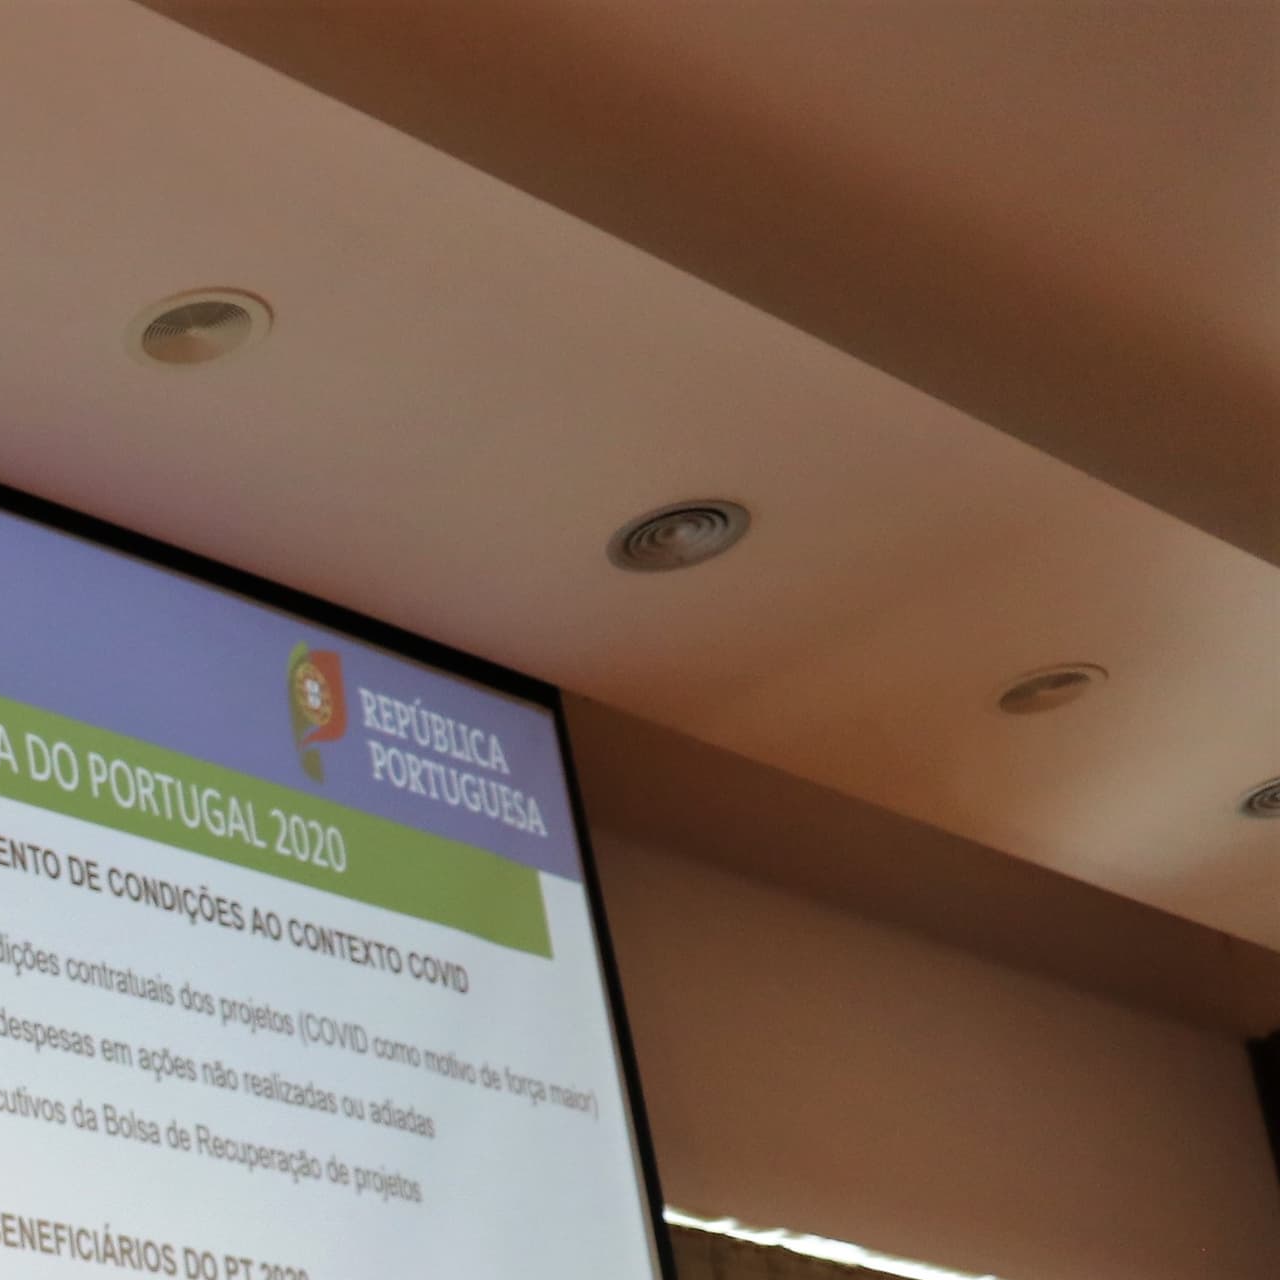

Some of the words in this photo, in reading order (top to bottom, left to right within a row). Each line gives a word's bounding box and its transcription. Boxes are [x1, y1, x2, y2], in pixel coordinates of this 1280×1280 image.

[357, 686, 510, 776] REPÚBLICA
[25, 732, 80, 791] DO
[88, 751, 267, 850] PORTUGAL
[272, 808, 347, 873] 2020
[366, 740, 548, 837] PORTUGUESA
[68, 855, 102, 894] DE
[107, 866, 246, 932] CONDIÇÕES
[251, 906, 283, 944] AO
[288, 918, 403, 976] CONTEXTO
[408, 952, 469, 995] COVID
[66, 956, 175, 1007] contratuais
[181, 982, 215, 1016] dos
[220, 996, 295, 1037] projetos
[297, 1012, 369, 1055] (COVID
[374, 1036, 420, 1069] como
[481, 1060, 502, 1091] de
[101, 1039, 133, 1067] em
[139, 1045, 198, 1082] ações
[202, 1058, 239, 1091] não
[242, 1069, 338, 1114] realizadas
[342, 1095, 364, 1121] ou
[370, 1097, 436, 1140] adiadas
[73, 1103, 99, 1133] da
[104, 1102, 161, 1145] Bolsa
[166, 1118, 192, 1152] de
[196, 1124, 323, 1182] Recuperação
[326, 1154, 350, 1186] de
[355, 1163, 423, 1203] projetos
